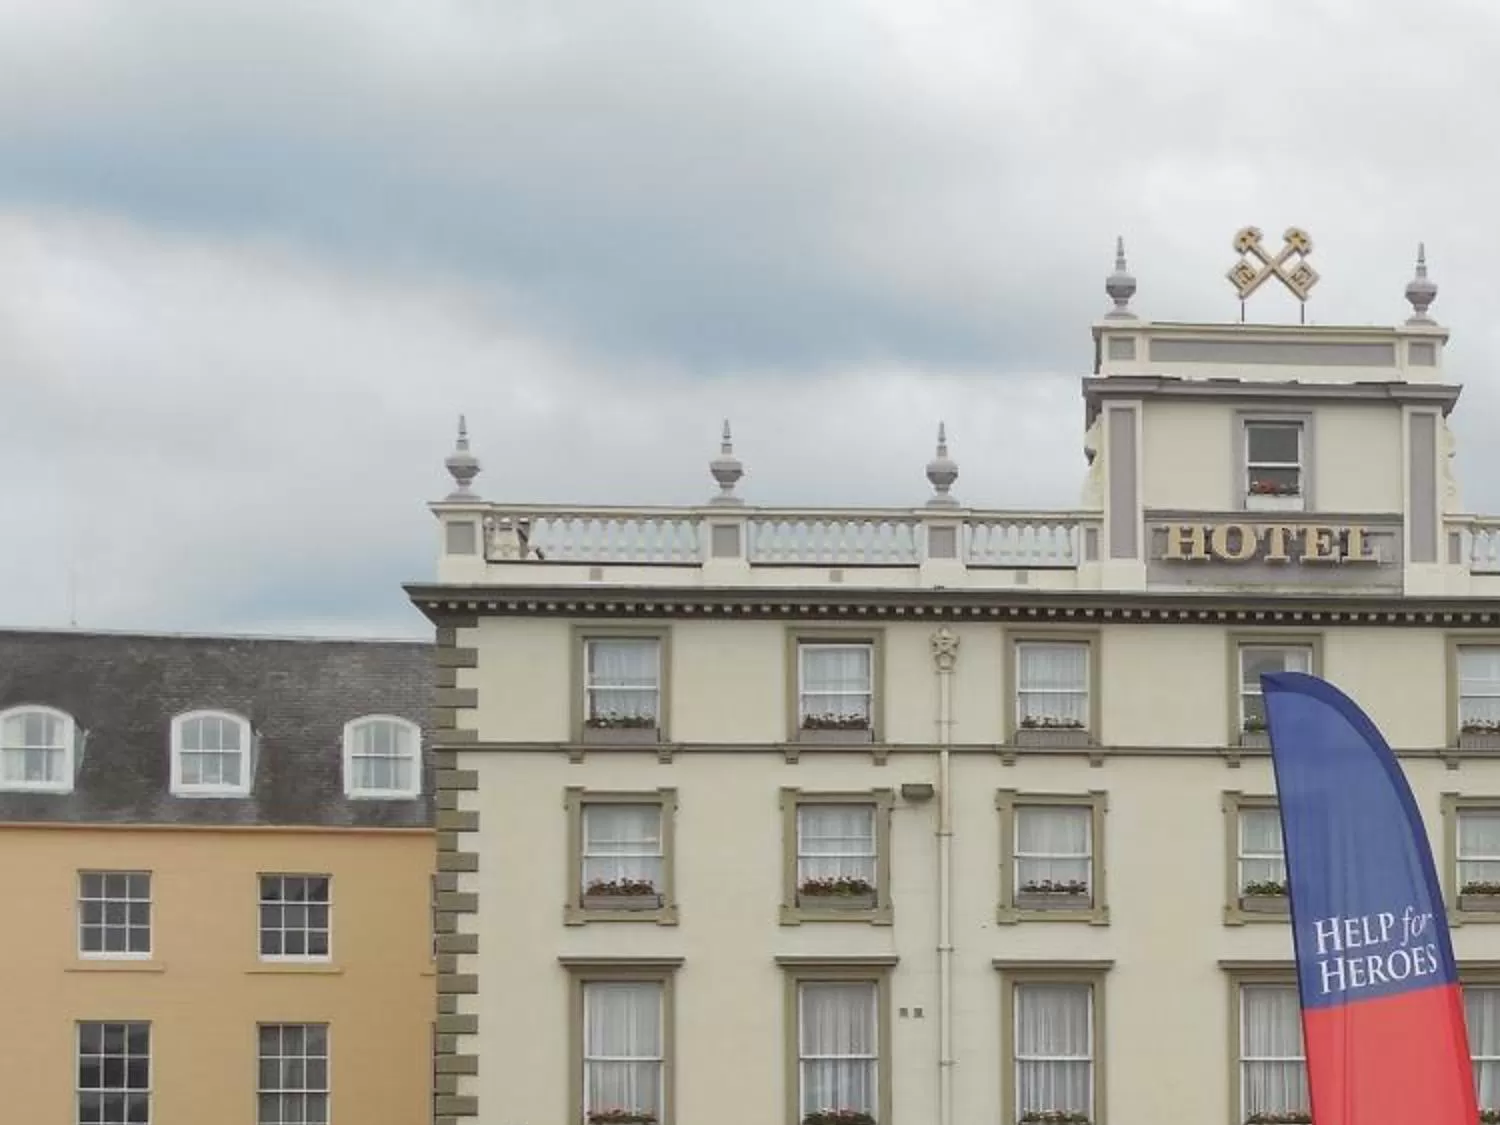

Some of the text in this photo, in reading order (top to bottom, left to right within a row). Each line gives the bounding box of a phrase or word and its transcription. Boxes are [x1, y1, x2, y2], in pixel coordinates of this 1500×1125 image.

[1160, 523, 1381, 564] HOTEL
[1313, 905, 1433, 955] HELP for
[1317, 943, 1438, 995] HEROES
